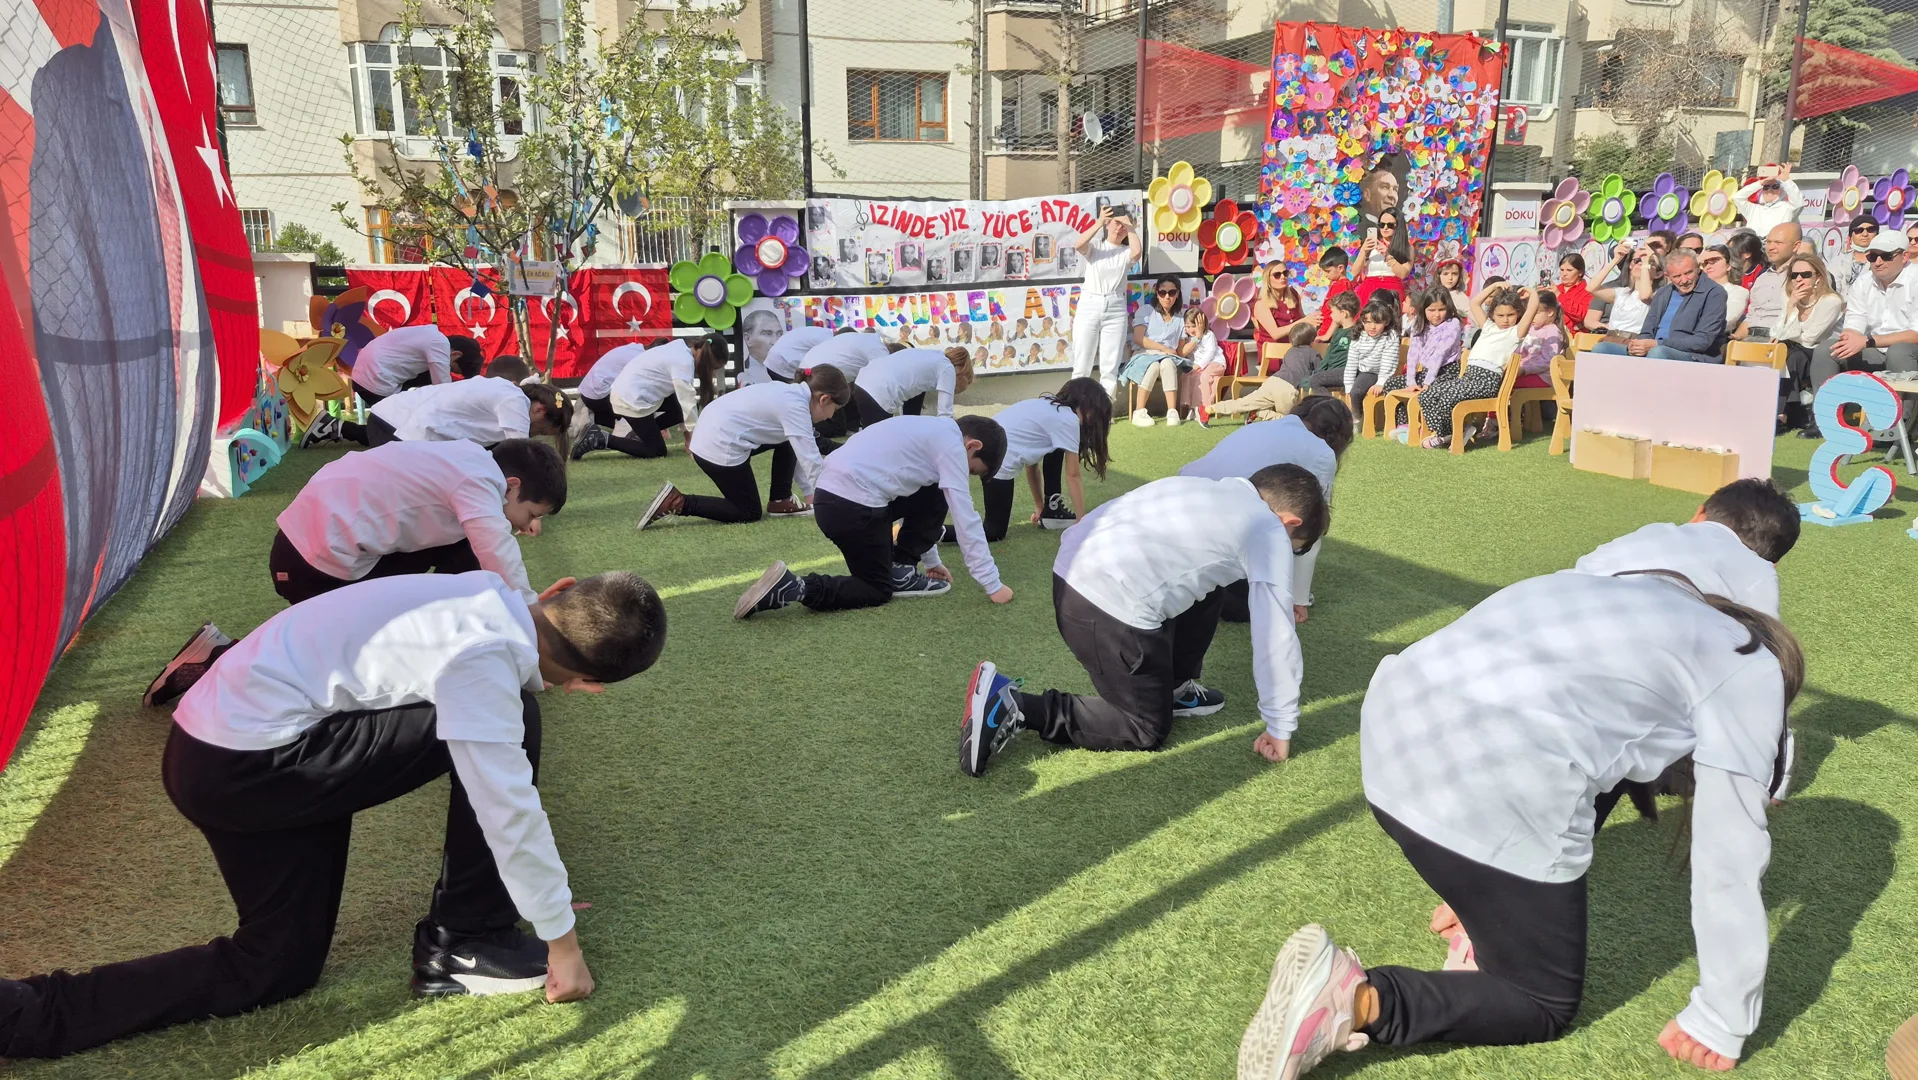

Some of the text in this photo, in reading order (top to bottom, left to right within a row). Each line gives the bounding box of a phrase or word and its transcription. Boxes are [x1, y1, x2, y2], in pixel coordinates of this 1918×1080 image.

[1804, 198, 1823, 208] OKU
[869, 201, 970, 239] İZİNDEYİZ
[982, 210, 1033, 239] YÜCE
[1505, 209, 1534, 220] DOKU
[1158, 231, 1191, 242] DOKU
